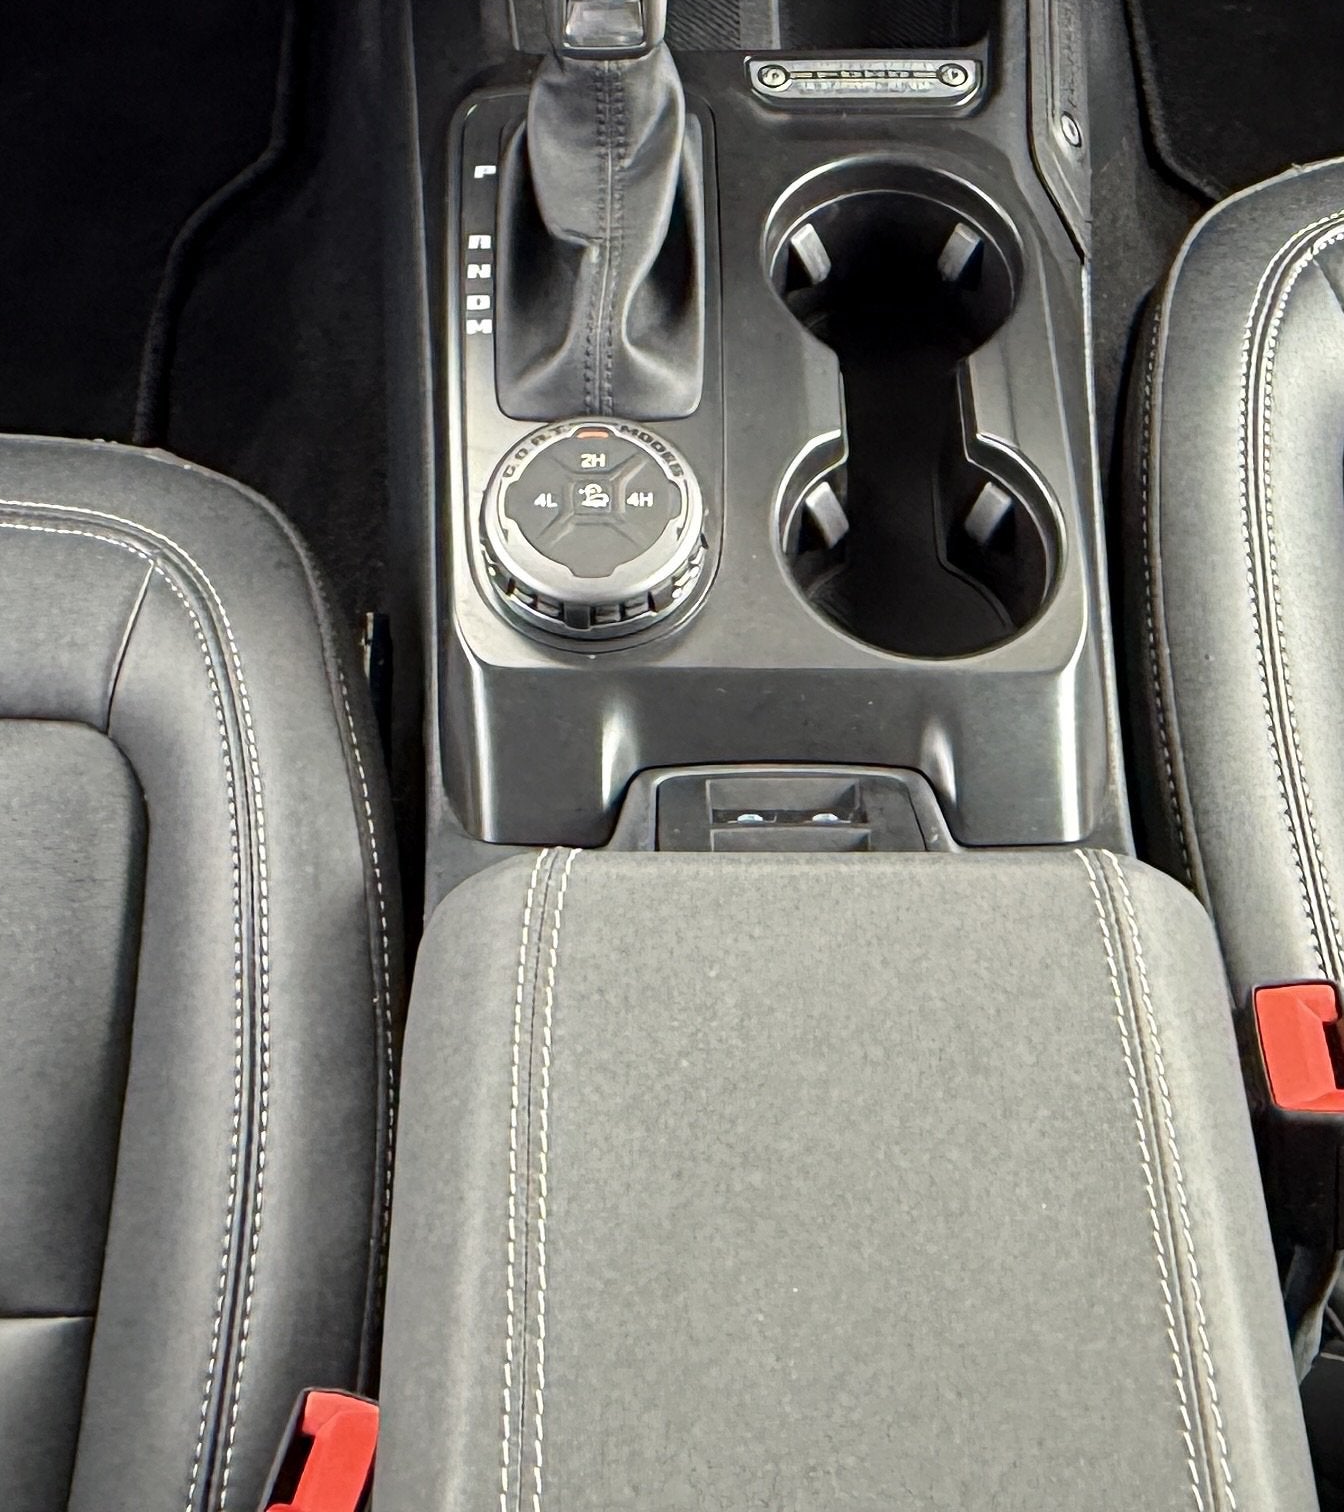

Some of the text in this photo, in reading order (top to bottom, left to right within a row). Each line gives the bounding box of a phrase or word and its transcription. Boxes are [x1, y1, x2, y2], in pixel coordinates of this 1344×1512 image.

[473, 164, 498, 180] P
[466, 263, 493, 280] N
[465, 294, 492, 311] D
[465, 318, 494, 336] M
[619, 424, 686, 478] MODES
[579, 452, 607, 469] 2H
[533, 492, 559, 509] 4L
[626, 491, 655, 508] 4H
